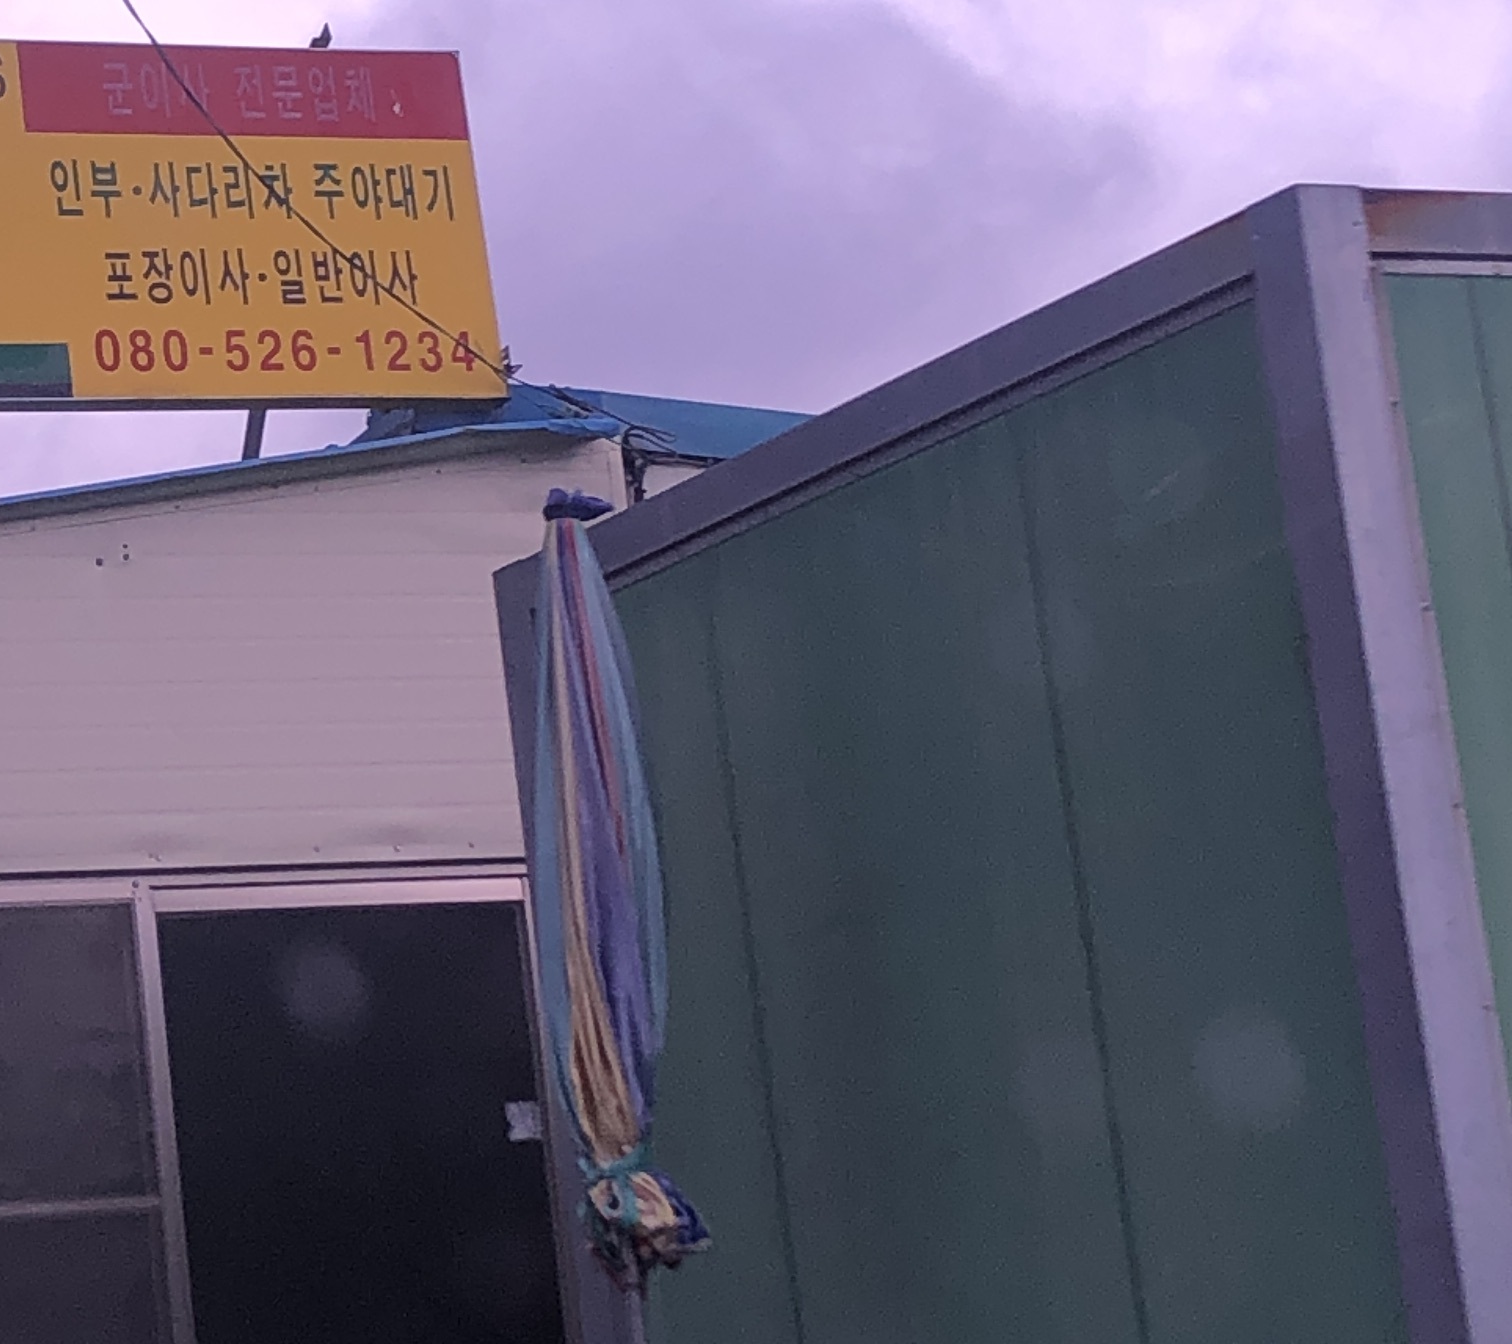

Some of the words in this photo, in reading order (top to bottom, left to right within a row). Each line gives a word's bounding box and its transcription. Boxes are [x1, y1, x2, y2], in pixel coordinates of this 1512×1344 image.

[234, 63, 377, 122] 전문업체
[313, 161, 456, 221] 주야대기
[105, 247, 419, 306] 포장이사·일반이사
[94, 329, 476, 374] 080-526-1234
